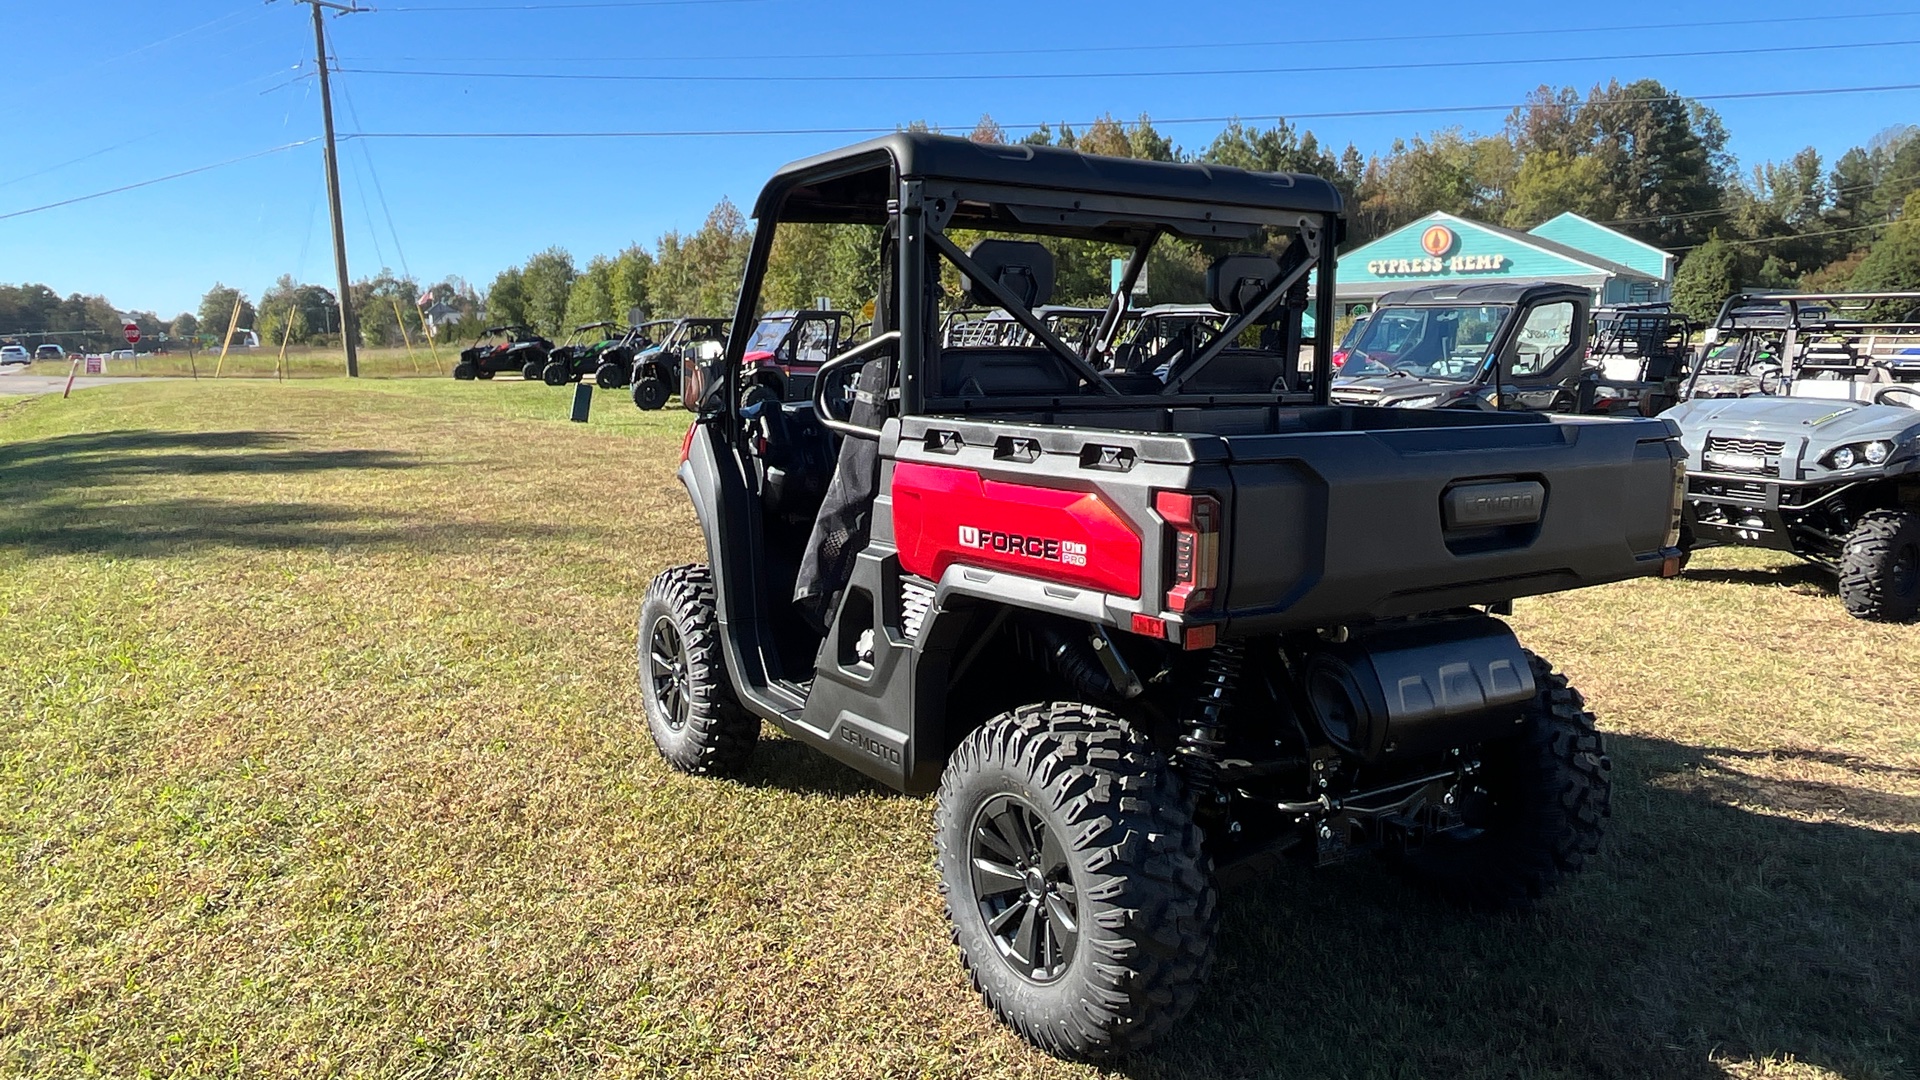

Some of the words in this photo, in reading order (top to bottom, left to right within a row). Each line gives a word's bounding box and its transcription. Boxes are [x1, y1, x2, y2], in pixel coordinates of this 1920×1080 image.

[1368, 257, 1443, 274] CYPRESS
[1450, 254, 1504, 271] HEMP
[124, 330, 140, 338] STOP
[1062, 552, 1087, 567] PRO
[841, 726, 900, 767] CFMOTO
